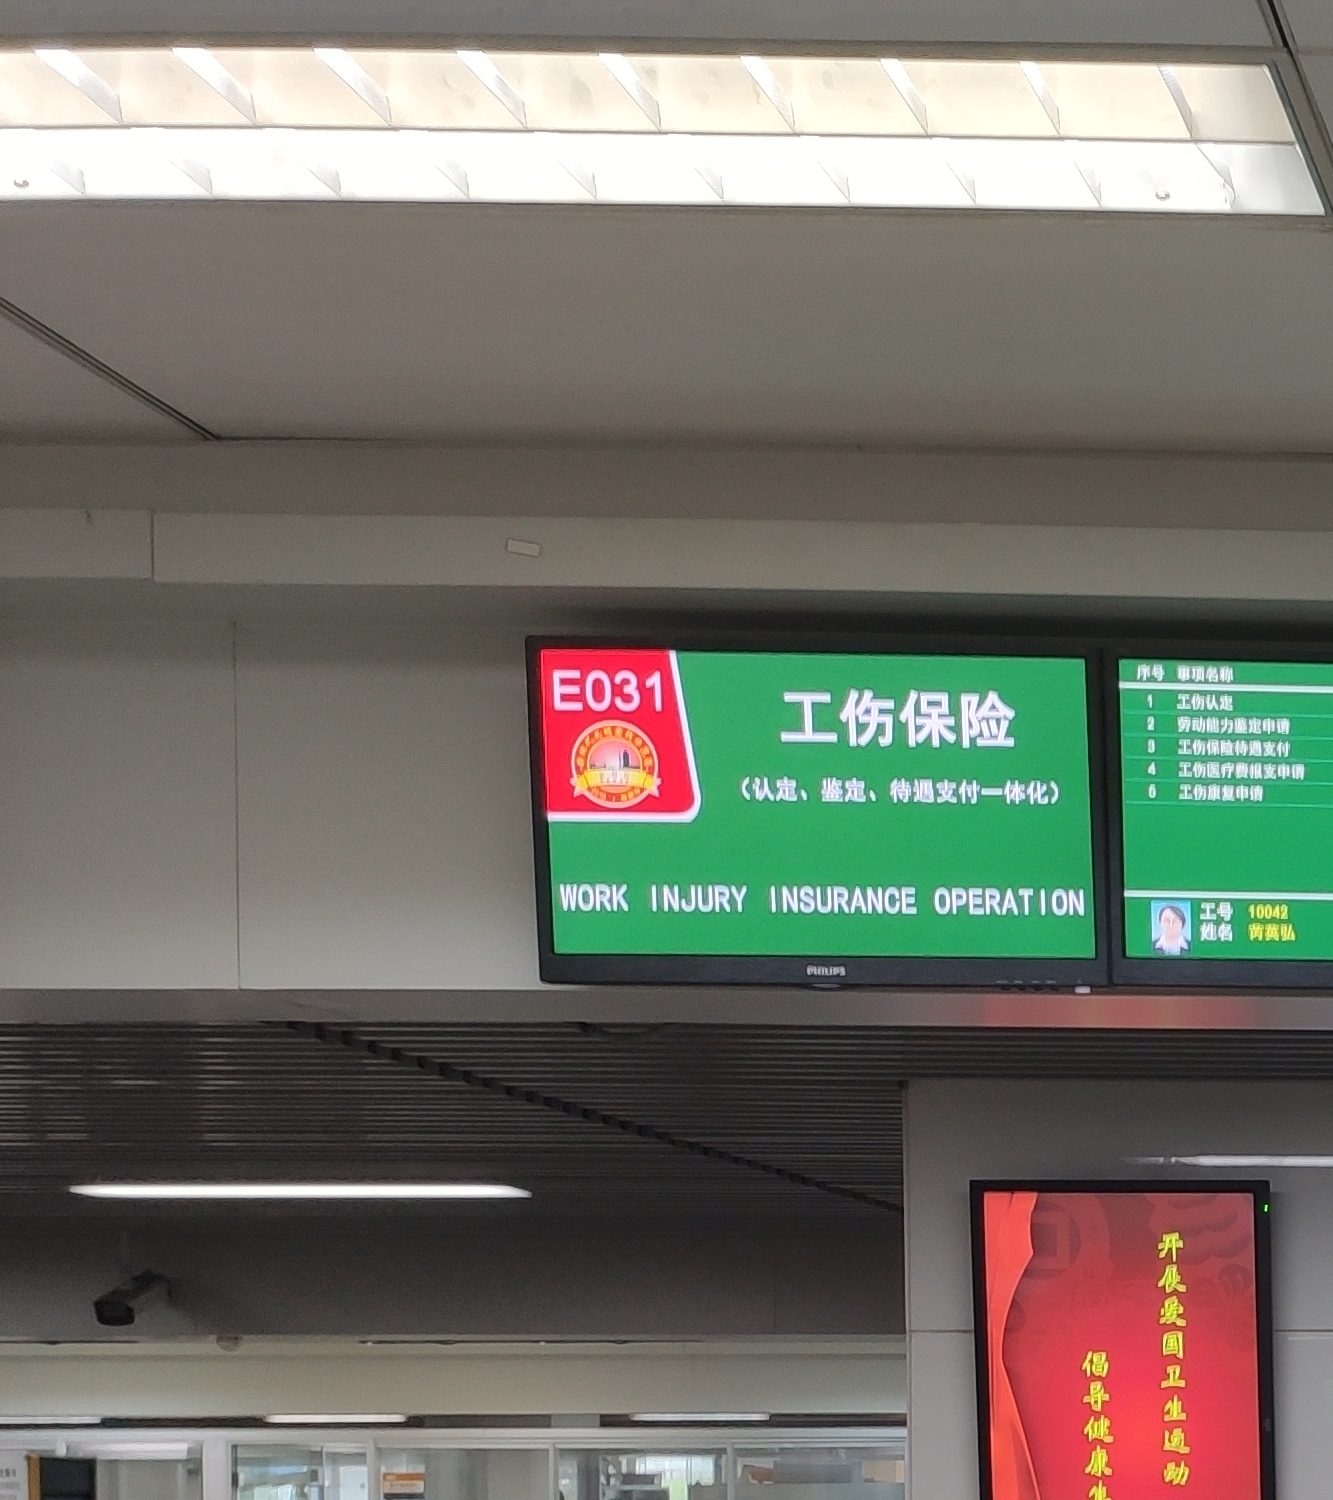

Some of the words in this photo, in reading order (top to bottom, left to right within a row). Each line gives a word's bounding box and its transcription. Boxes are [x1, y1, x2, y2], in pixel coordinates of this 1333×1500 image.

[552, 669, 664, 712] E031
[1177, 694, 1233, 711] 工伤认定
[780, 688, 1016, 749] 工伤保险
[559, 883, 629, 912] WORK
[651, 884, 747, 914] INJURY
[770, 884, 917, 915] INSURANCE
[934, 886, 1085, 917] OPERATION
[1200, 903, 1233, 921] 工号
[1201, 923, 1233, 943] 姓名
[1157, 1231, 1191, 1486] 开展爱国卫生运动
